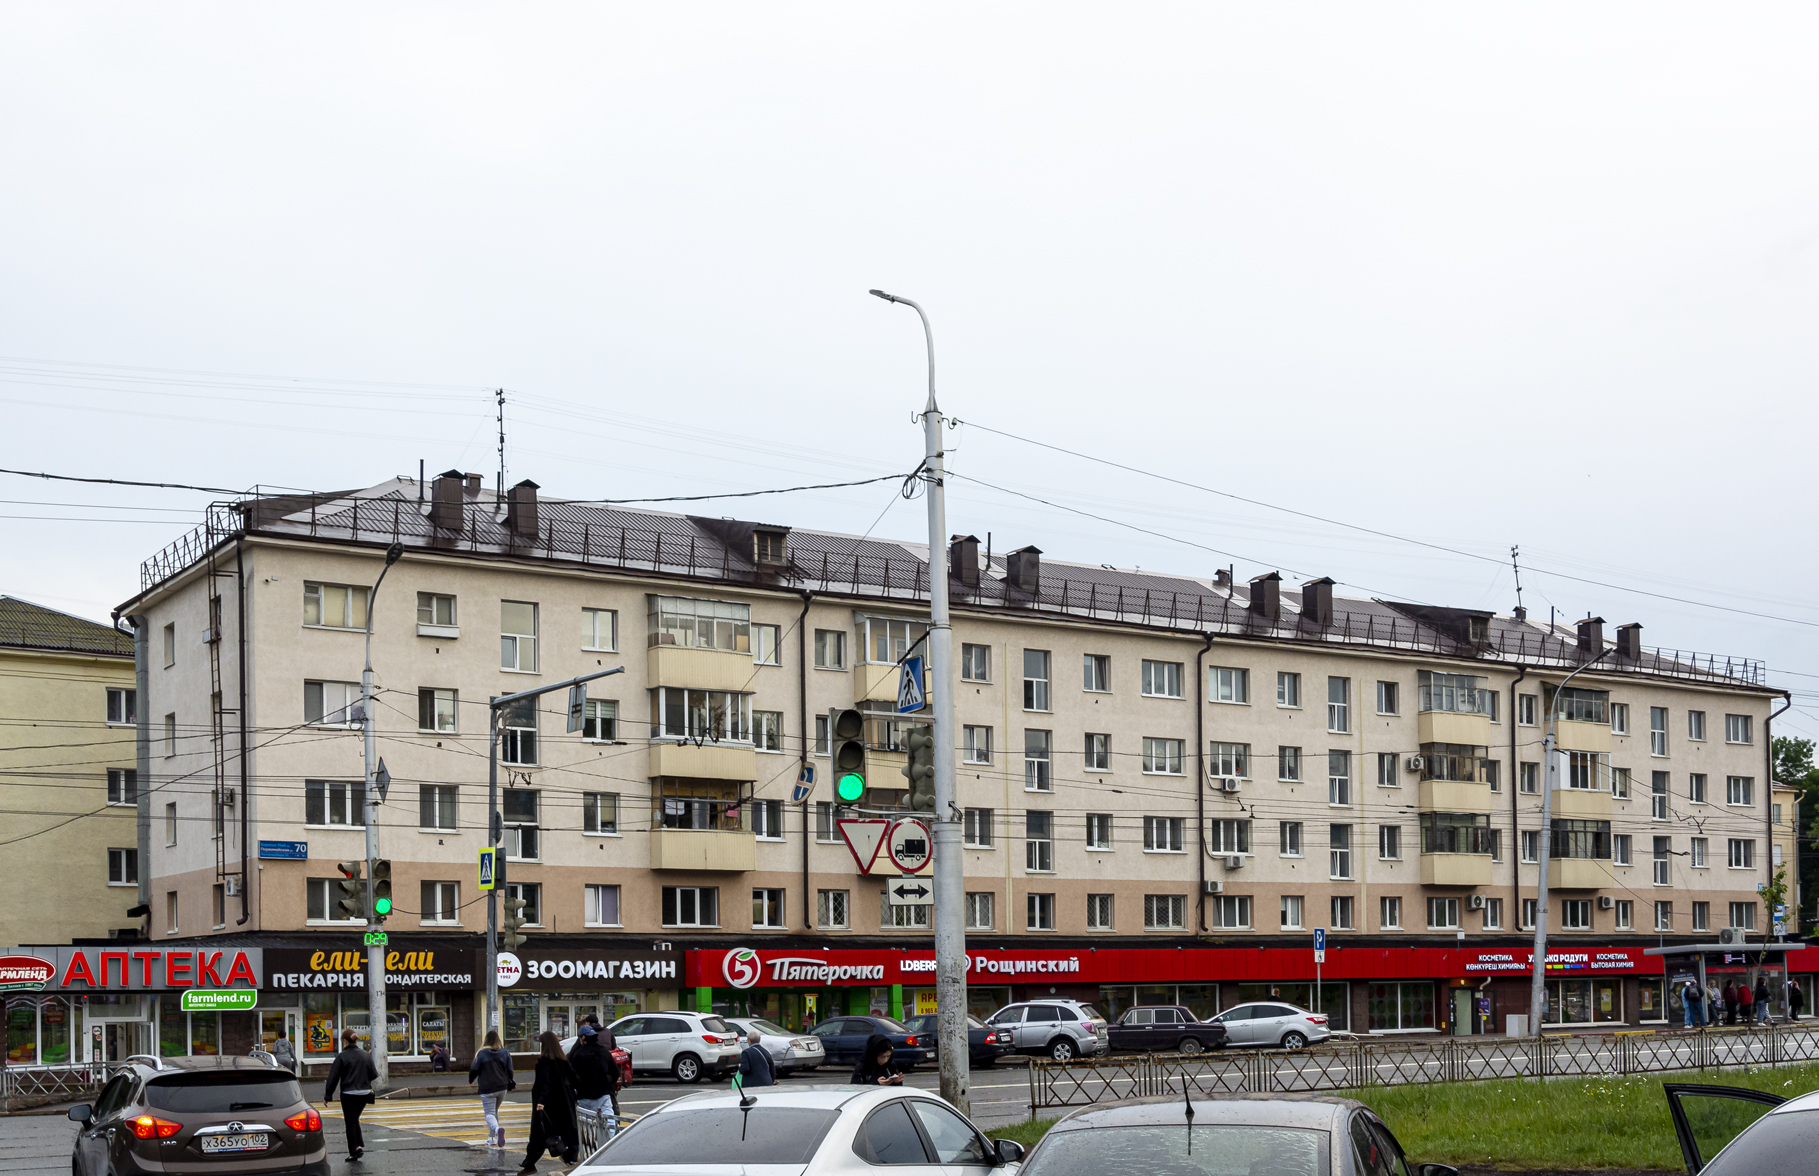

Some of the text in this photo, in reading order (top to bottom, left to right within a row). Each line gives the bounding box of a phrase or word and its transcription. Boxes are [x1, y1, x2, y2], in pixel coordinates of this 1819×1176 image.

[294, 843, 307, 853] 70
[310, 951, 434, 971] ели-ели
[1478, 954, 1513, 962] КОСМЕТИКА
[61, 951, 258, 987] АПТЕКА
[496, 966, 520, 974] ЕТНА
[527, 960, 676, 979] ЗООМАГАЗИН
[900, 959, 937, 971] LDBERR
[975, 956, 1080, 975] Рощинский
[0, 970, 48, 980] РМЛЕНД
[272, 973, 472, 988] ПЕКАРНЯ ОНДИТЕРСКАЯ
[187, 992, 251, 1003] farmlend.ru
[921, 993, 937, 1003] АРЕ
[205, 1134, 265, 1148] Х365УО 102
